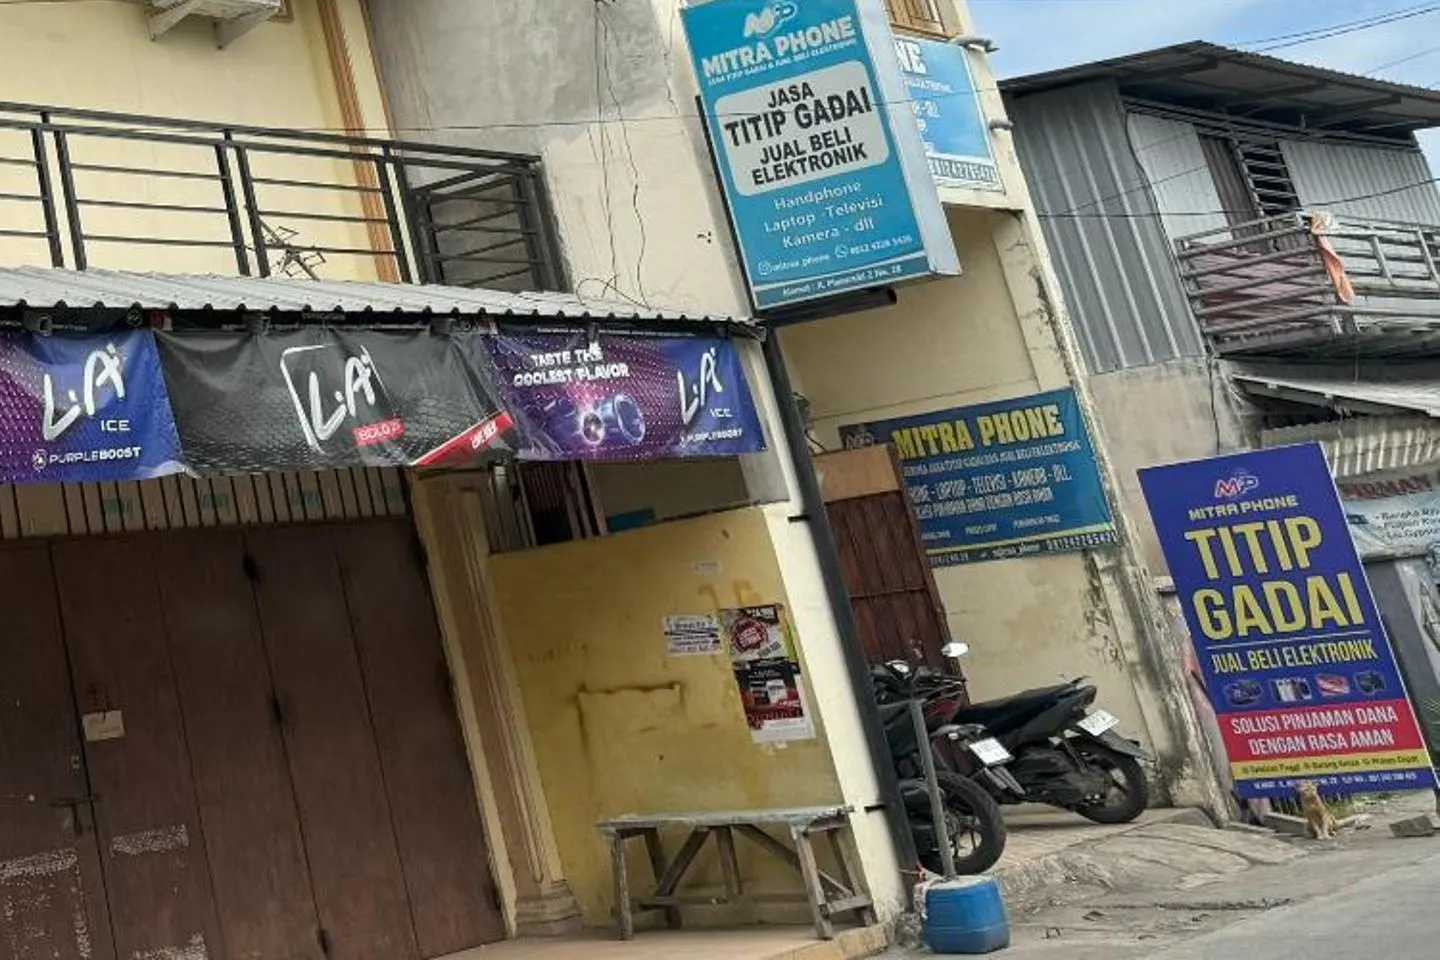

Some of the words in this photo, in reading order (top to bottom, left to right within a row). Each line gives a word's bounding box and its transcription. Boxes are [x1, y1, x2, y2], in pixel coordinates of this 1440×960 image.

[701, 41, 773, 78] MITRA
[774, 15, 856, 57] PHONE
[768, 82, 815, 108] JASA
[724, 109, 786, 147] TITIP
[794, 86, 872, 130] GADAI
[760, 139, 806, 165] JUAL
[809, 126, 853, 153] BELI
[751, 142, 868, 186] ELEKTRONIK
[774, 181, 862, 210] Handphone
[764, 213, 816, 234] Laptop
[782, 226, 840, 249] Kamera
[531, 349, 572, 367] TASTE
[513, 368, 574, 388] COOLEST
[575, 362, 630, 383] FLAVOR
[101, 419, 131, 432] ICE
[891, 419, 975, 461] MITRA
[976, 403, 1065, 448] PHONE
[1188, 503, 1239, 521] MITRA
[1240, 494, 1299, 514] PHONE
[1184, 515, 1323, 581] TITIP
[1192, 572, 1366, 641] GADAI
[1212, 652, 1249, 674] JUAL
[1247, 647, 1283, 670] BELI
[1282, 639, 1378, 666] ELEKTRONIK
[1231, 714, 1281, 735] SOLUSI
[1281, 709, 1355, 731] PINJAMAN
[1356, 705, 1398, 725] DANA
[1248, 734, 1308, 756] DENGAN
[1309, 732, 1350, 752] RASA
[1351, 728, 1395, 748] AMAN
